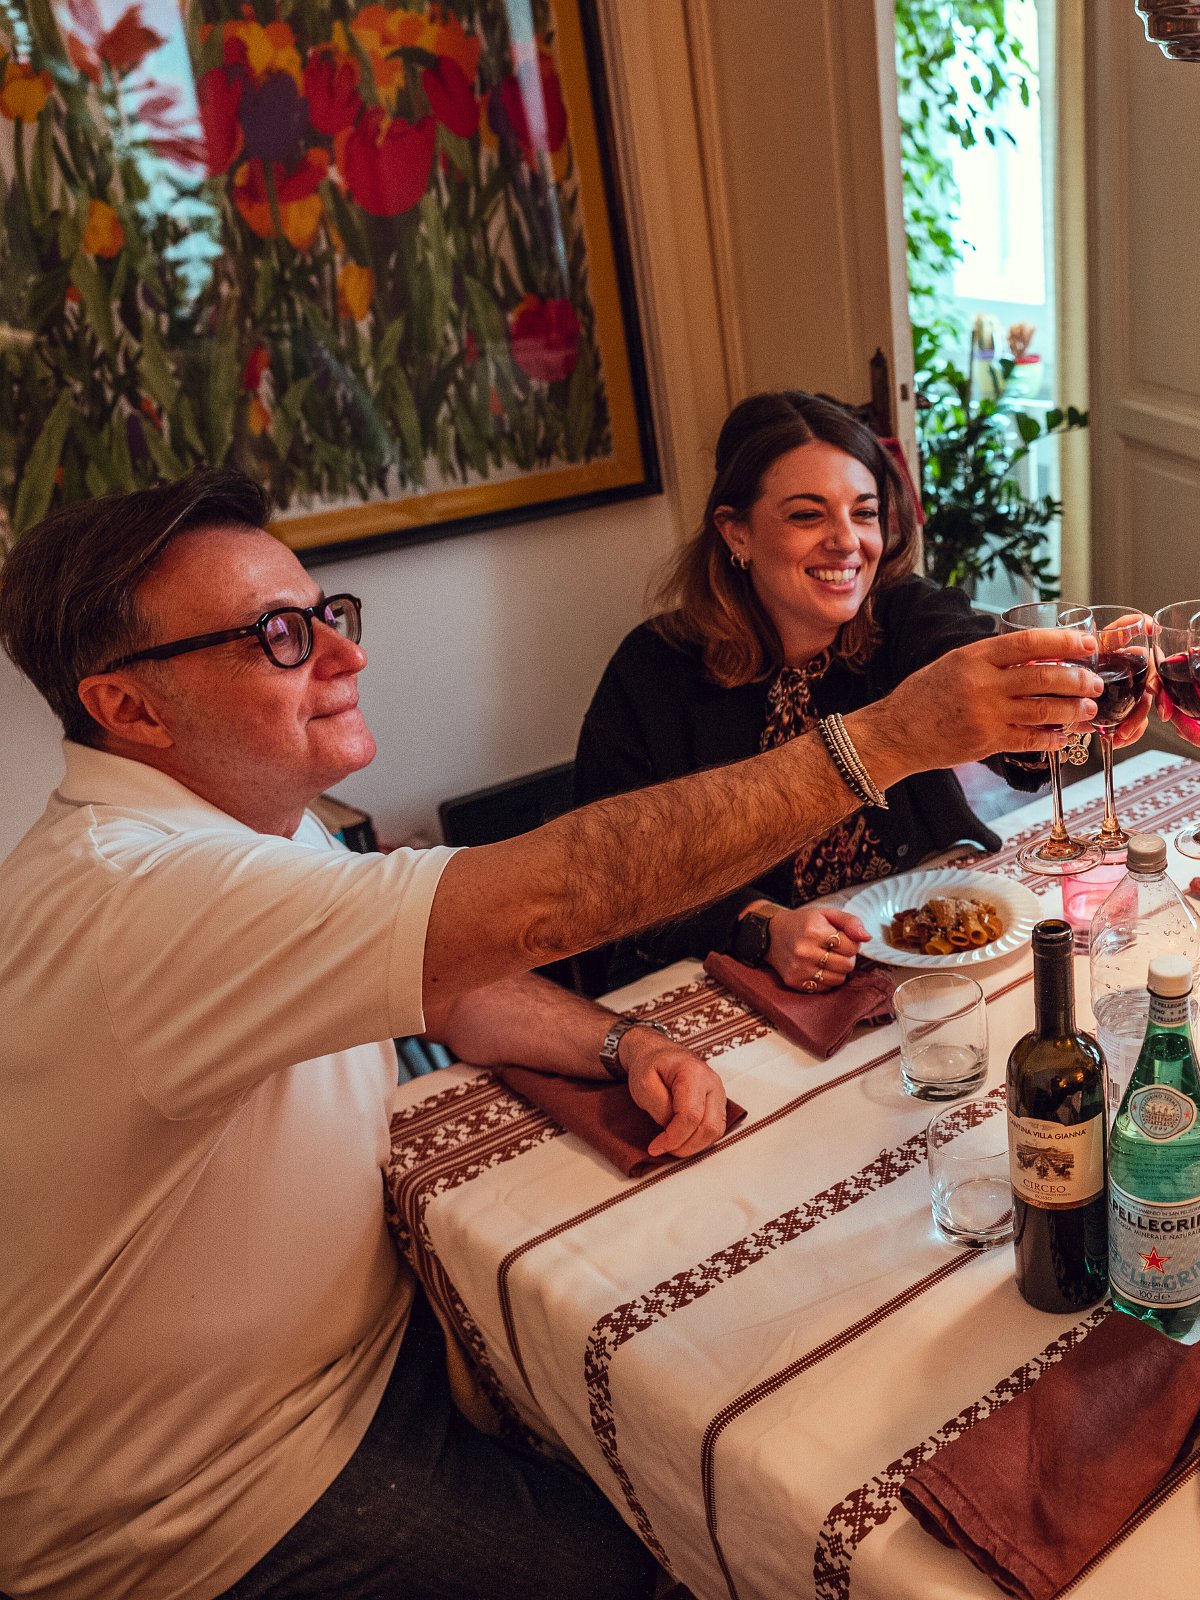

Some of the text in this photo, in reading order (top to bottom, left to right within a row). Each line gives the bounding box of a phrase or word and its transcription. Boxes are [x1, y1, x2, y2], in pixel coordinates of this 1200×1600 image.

[1033, 1130, 1053, 1140] VILLA
[1023, 1178, 1066, 1194] CIRCEO
[1114, 1216, 1132, 1232] ACQUA
[1133, 1229, 1167, 1241] MINERALE
[1138, 1289, 1153, 1300] 100
